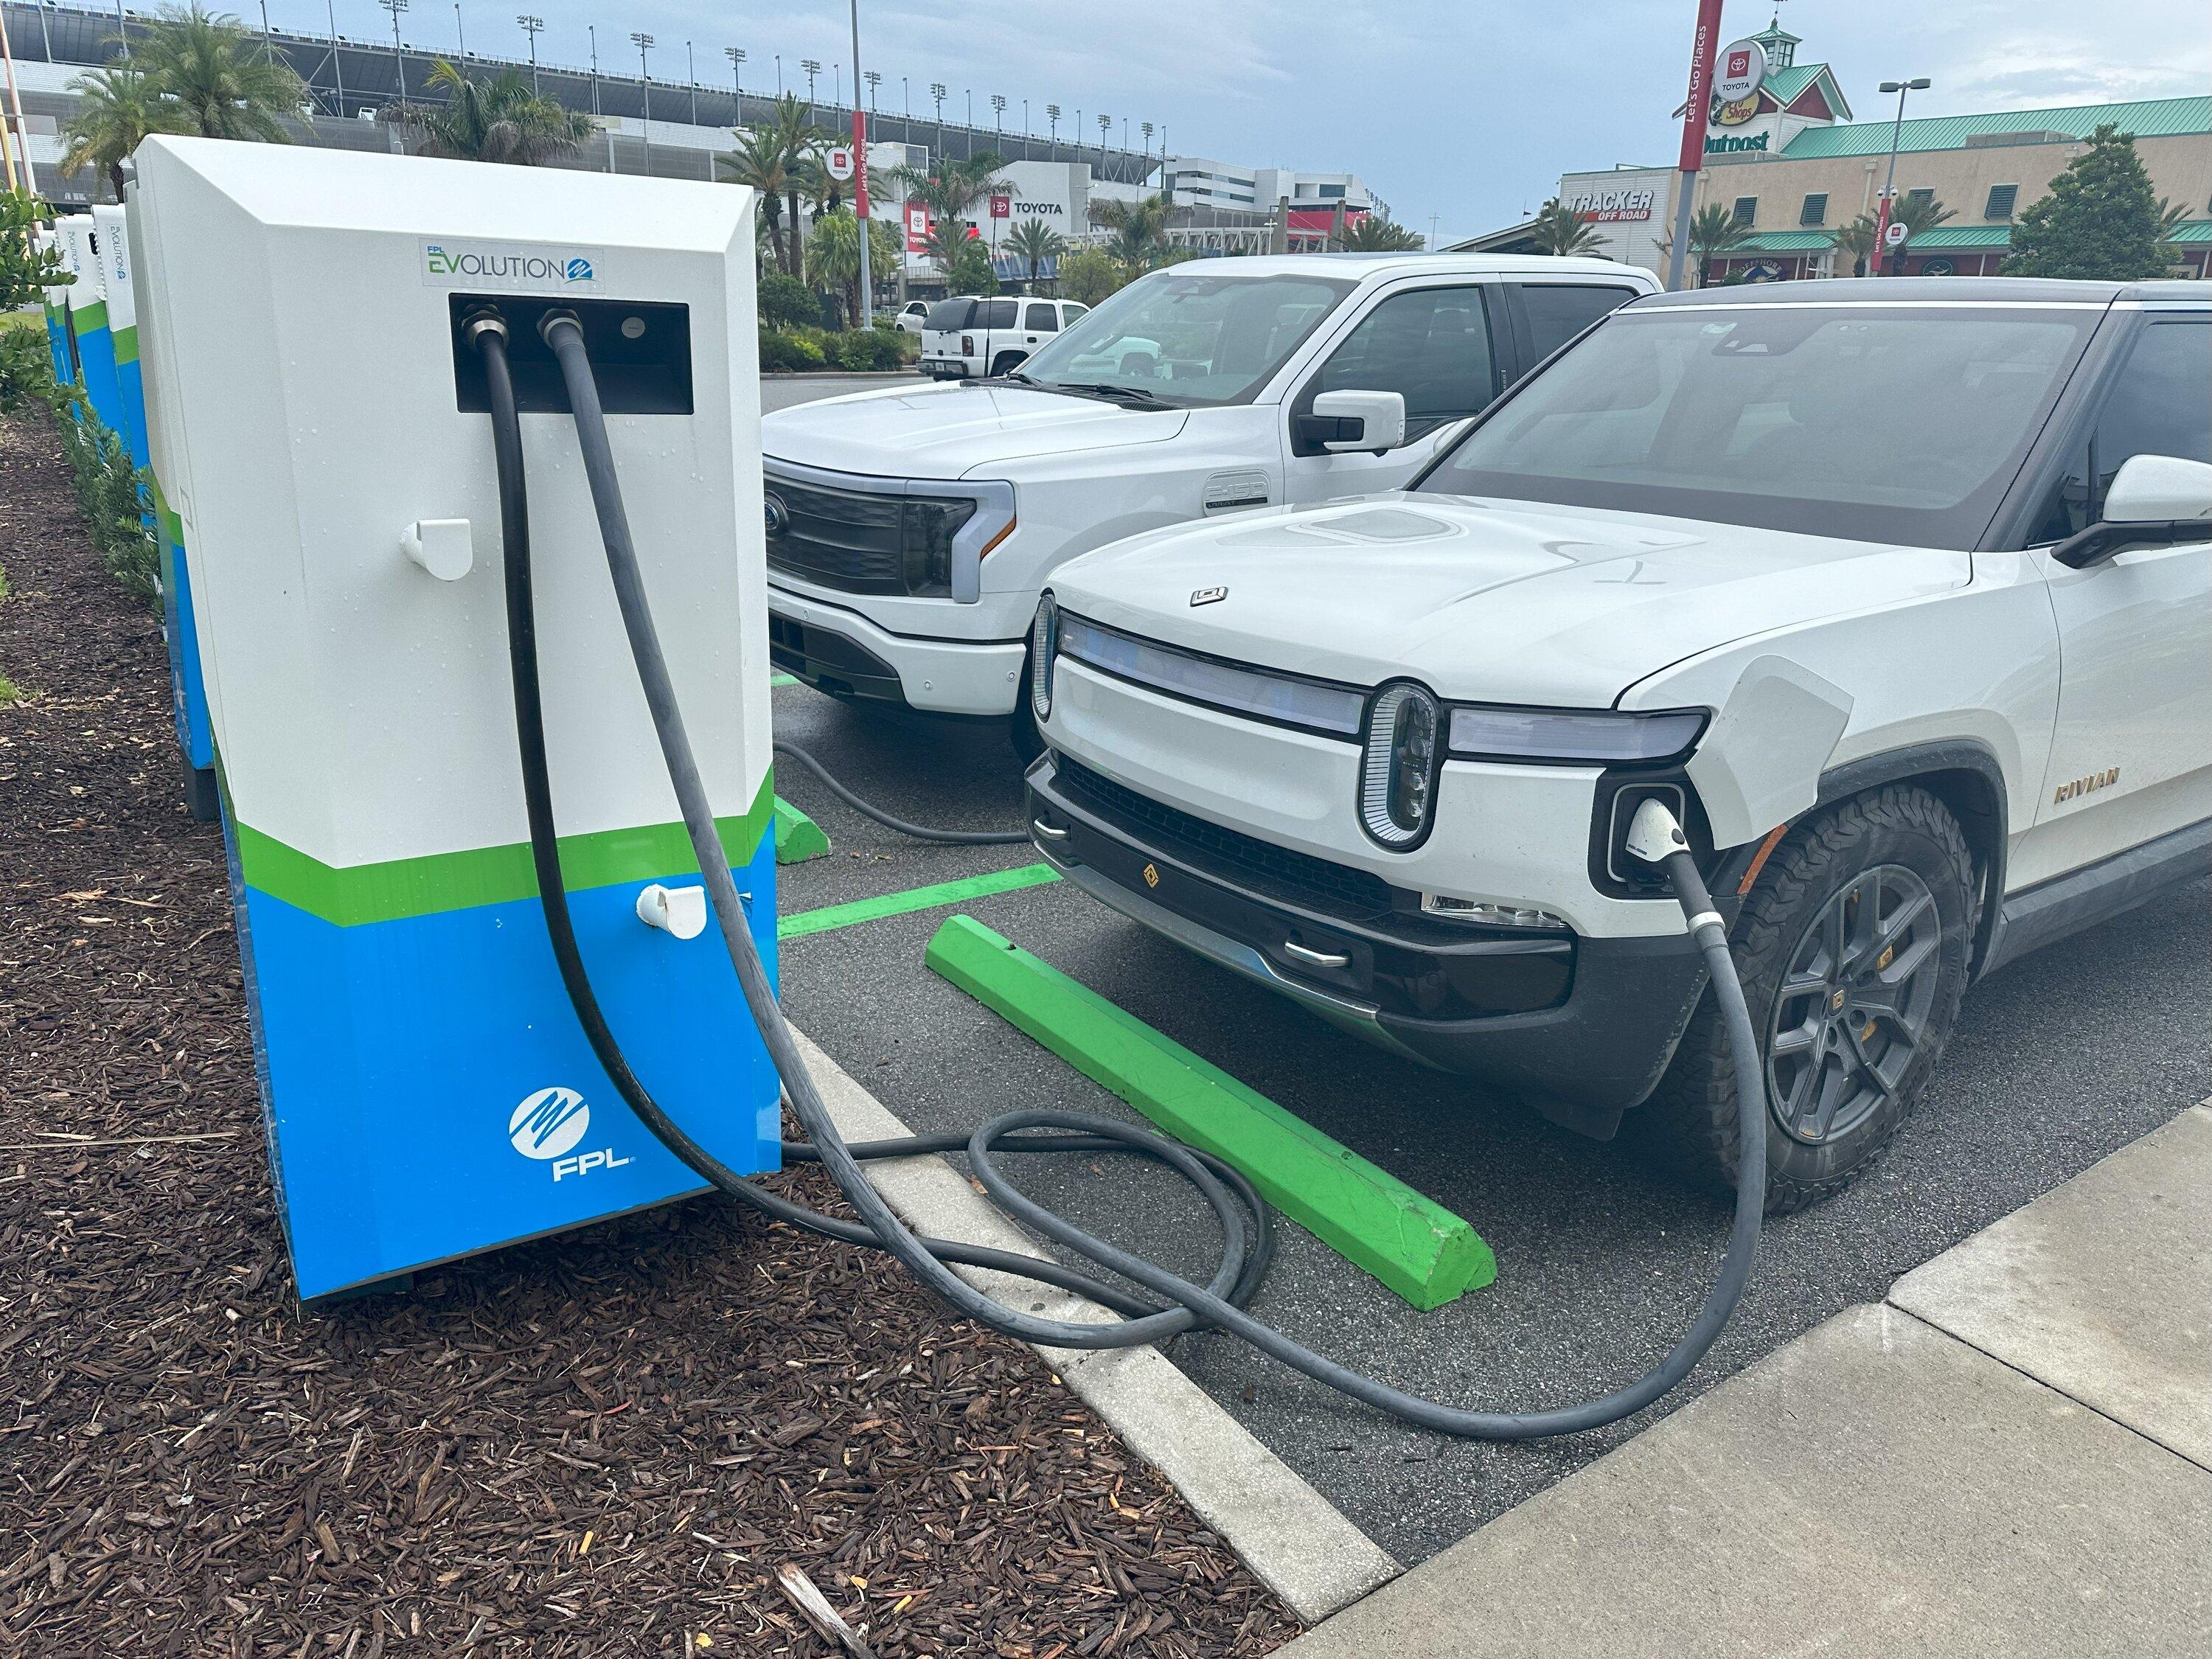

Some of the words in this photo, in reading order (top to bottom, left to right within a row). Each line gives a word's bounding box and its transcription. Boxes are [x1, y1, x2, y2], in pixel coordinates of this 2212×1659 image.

[1692, 25, 1707, 67] Places
[1690, 70, 1700, 91] Go
[1722, 82, 1750, 91] TOYOTA
[1686, 94, 1697, 123] Let's
[1725, 107, 1753, 120] Shops
[860, 163, 867, 175] Go
[1014, 202, 1063, 215] TOYOTA
[1570, 189, 1654, 212] TRACKER
[1598, 211, 1618, 221] OFF
[1618, 210, 1648, 220] ROAD
[427, 246, 445, 254] FPL
[428, 252, 566, 279] EVOLUTION
[1739, 258, 1783, 274] OFFSHORE
[1205, 481, 1267, 501] F-150
[2053, 765, 2121, 804] RIVIAN
[552, 1147, 630, 1183] FPL
